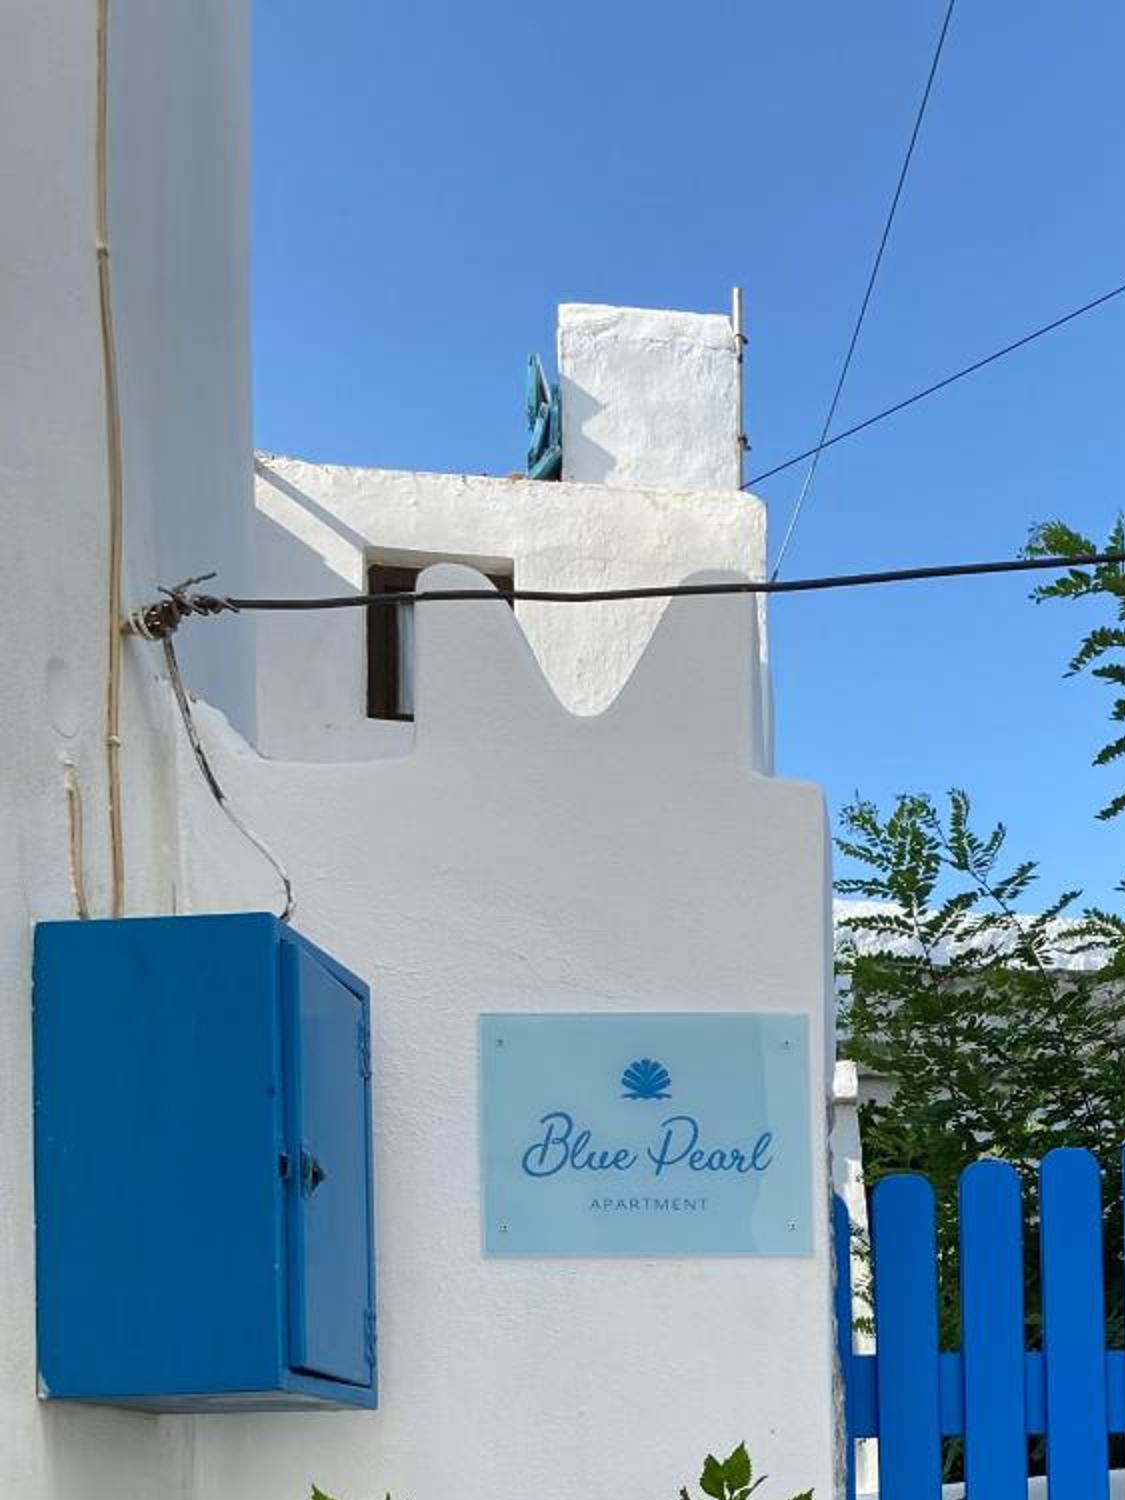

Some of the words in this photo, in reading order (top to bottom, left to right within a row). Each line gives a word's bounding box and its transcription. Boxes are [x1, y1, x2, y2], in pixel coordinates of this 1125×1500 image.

[521, 1111, 638, 1178] Blue
[647, 1115, 774, 1177] Pearl
[590, 1198, 708, 1211] APARTMENT
